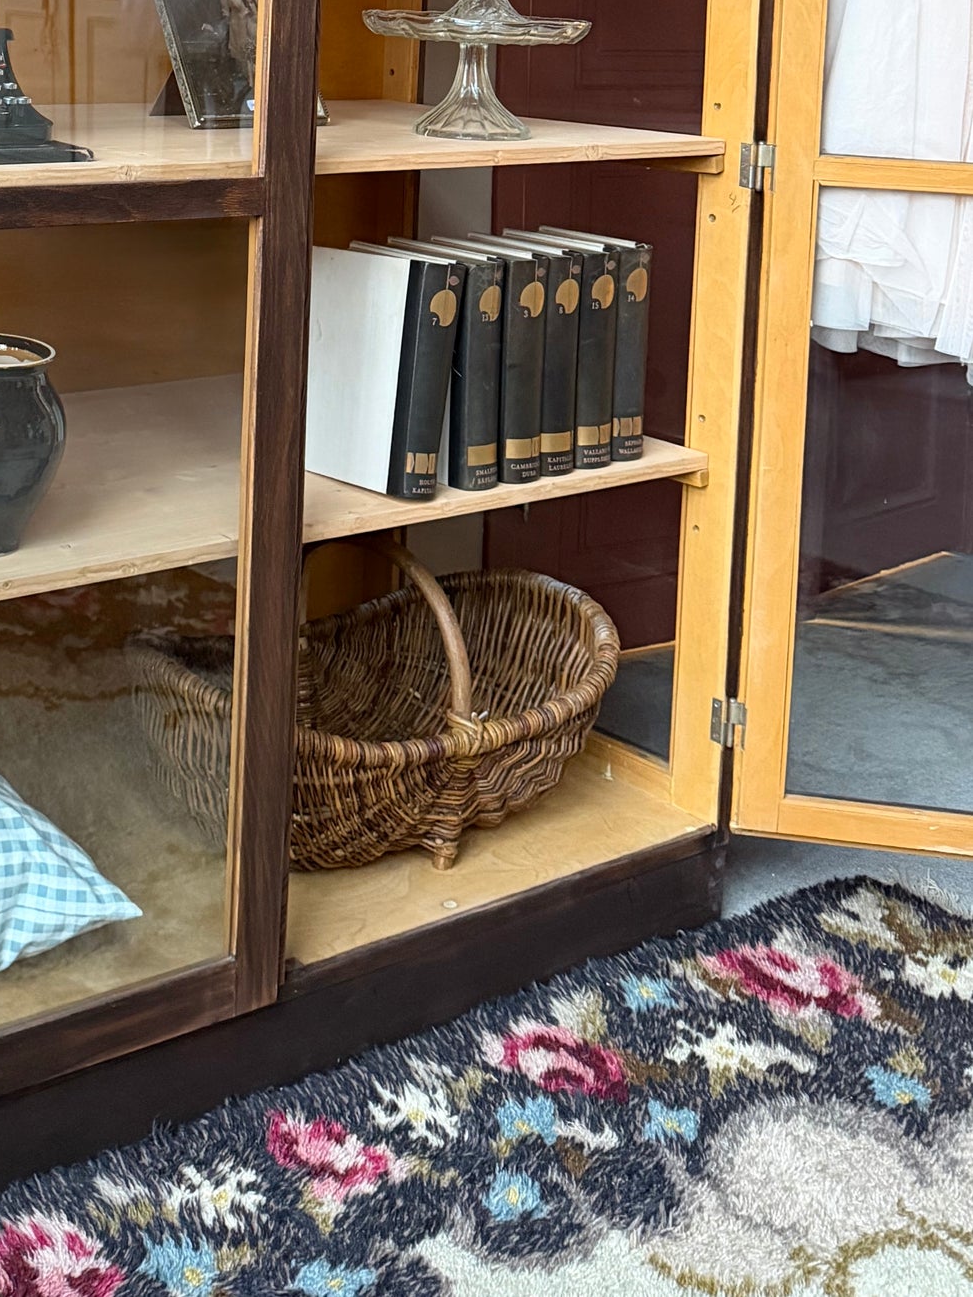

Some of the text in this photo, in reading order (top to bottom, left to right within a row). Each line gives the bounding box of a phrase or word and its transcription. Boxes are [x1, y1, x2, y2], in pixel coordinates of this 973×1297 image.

[627, 294, 635, 303] 14
[592, 301, 600, 310] 15
[432, 317, 438, 326] 7
